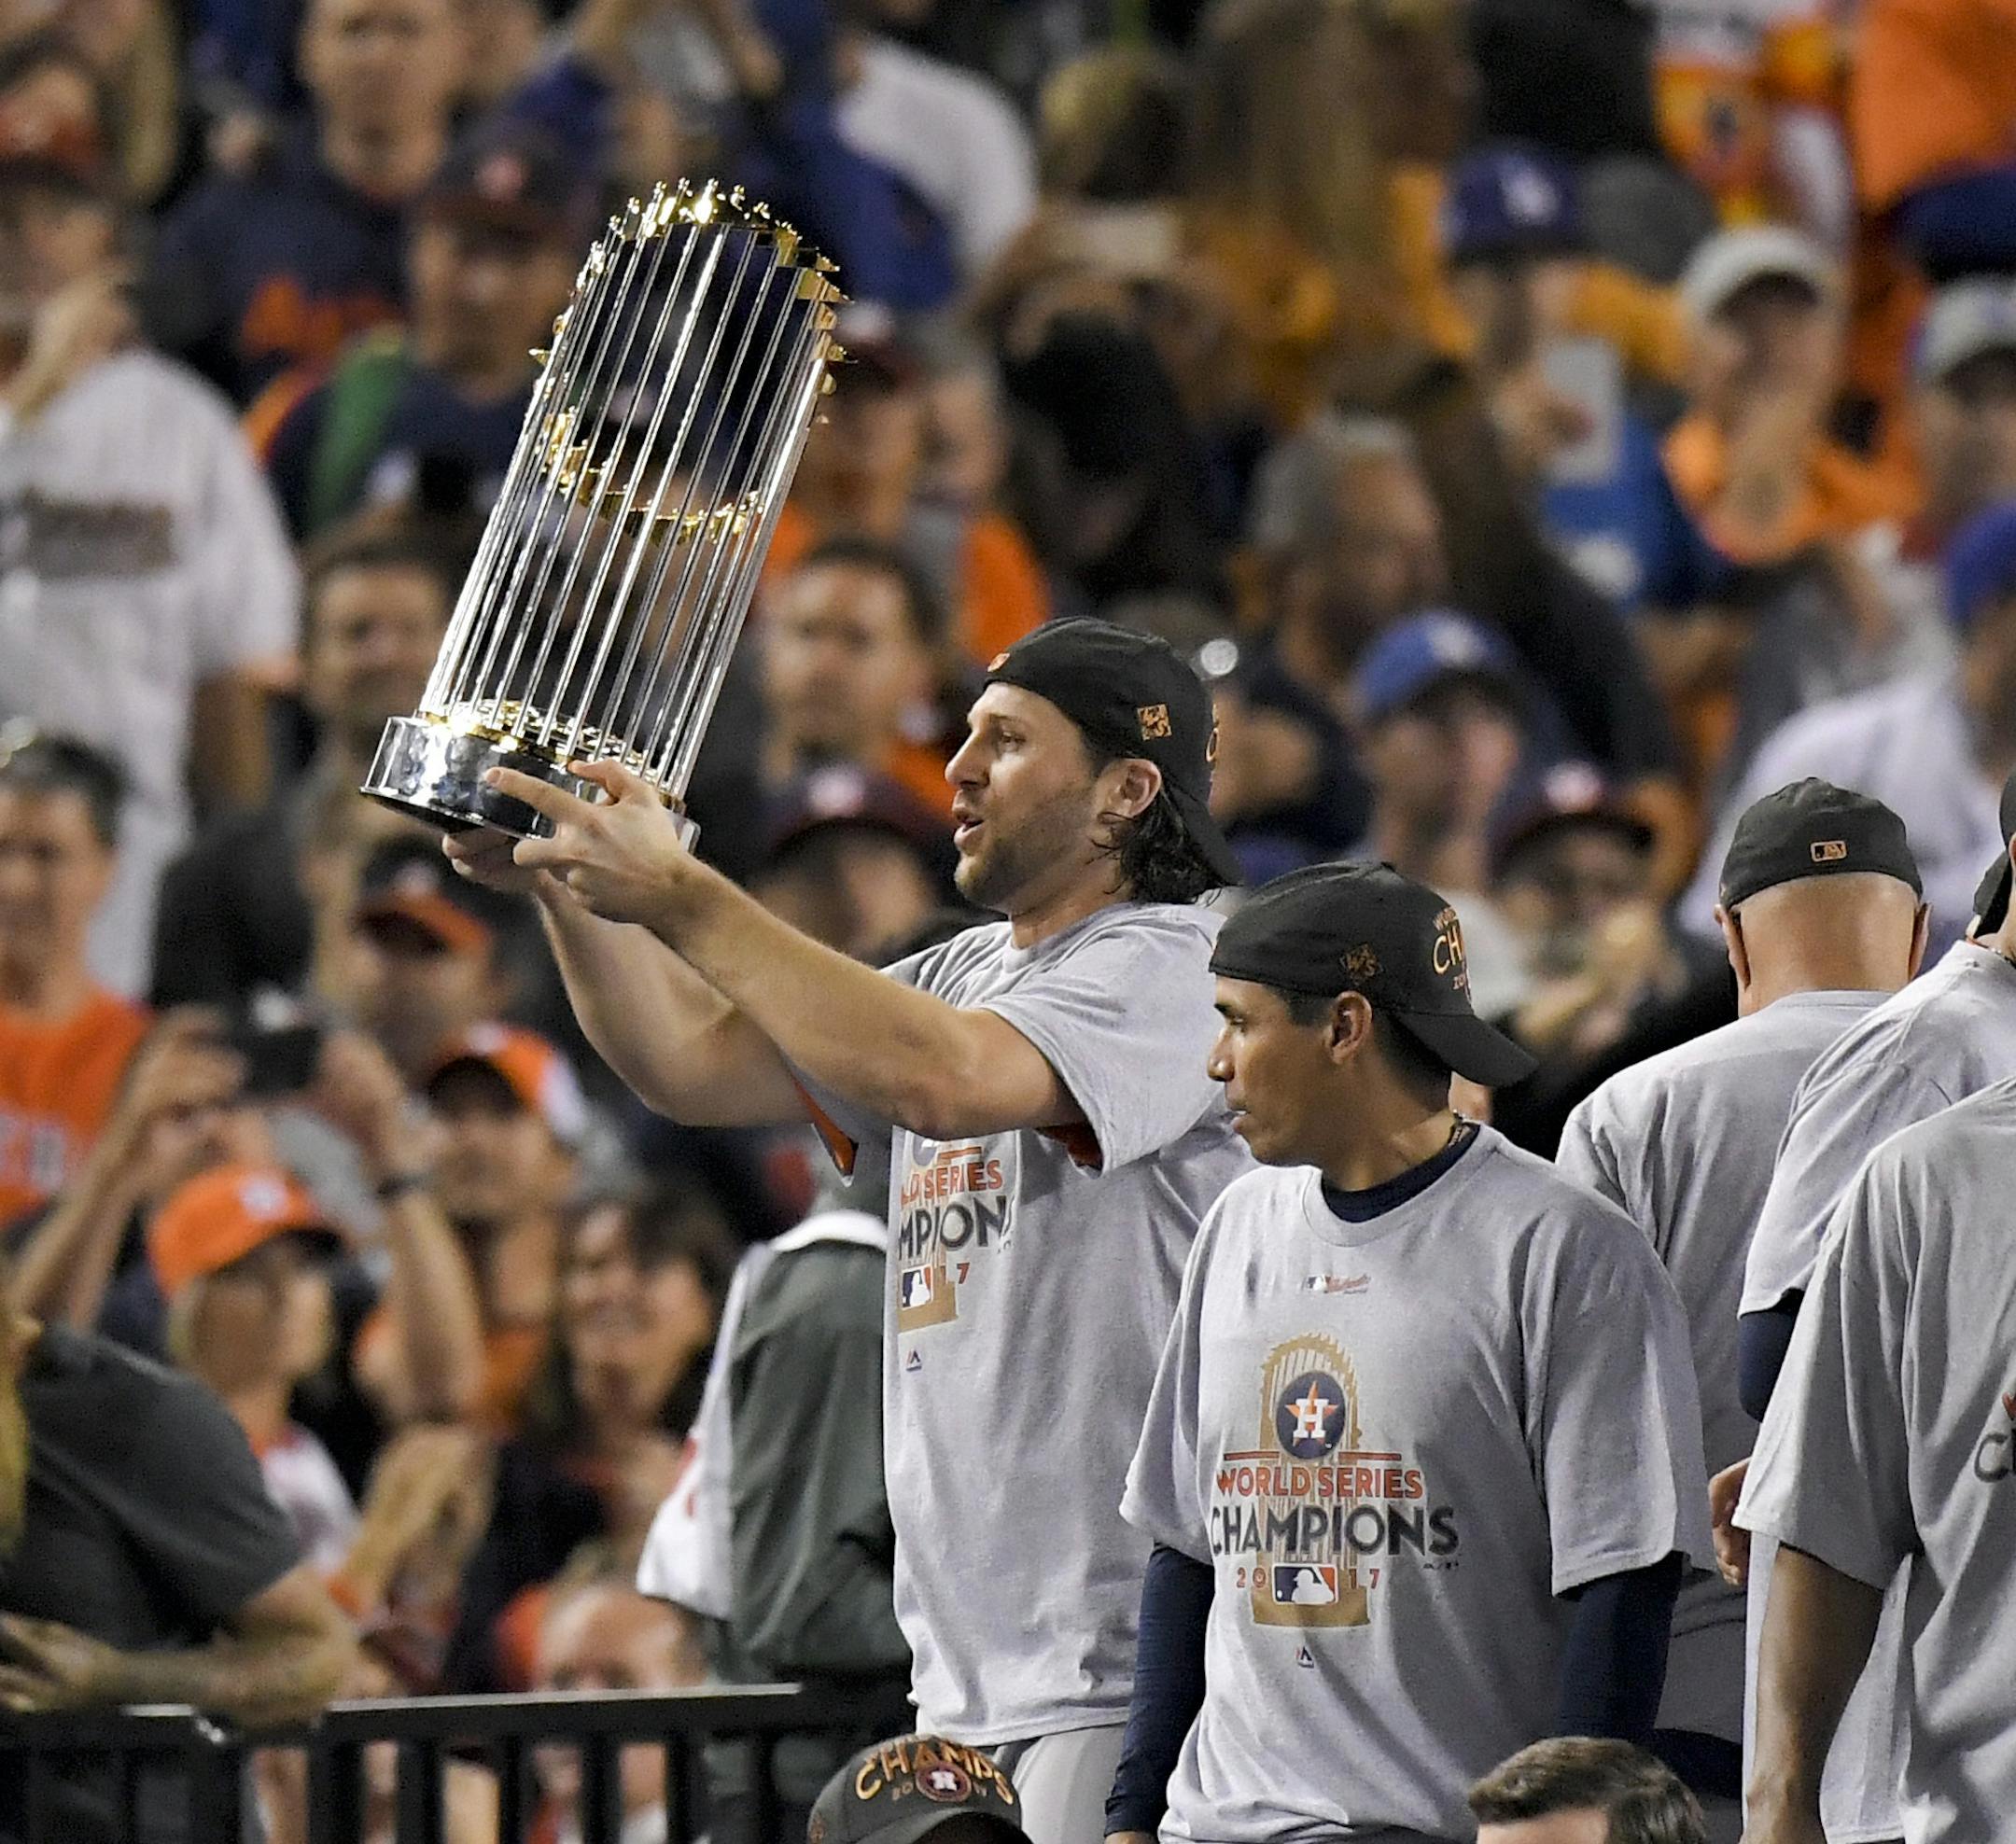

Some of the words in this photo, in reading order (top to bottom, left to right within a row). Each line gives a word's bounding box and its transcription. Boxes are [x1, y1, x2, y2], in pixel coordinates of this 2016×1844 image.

[924, 1159, 1003, 1199] SERIES
[898, 1195, 1015, 1261] MPION
[1293, 1398, 1330, 1438] H
[1216, 1466, 1311, 1497] WORLD
[1317, 1468, 1424, 1499] SERIES
[1211, 1502, 1460, 1558] CHAMPIONS
[1237, 1567, 1267, 1588] 20
[1349, 1568, 1380, 1589] 17
[856, 1739, 1014, 1806] CHAMPS
